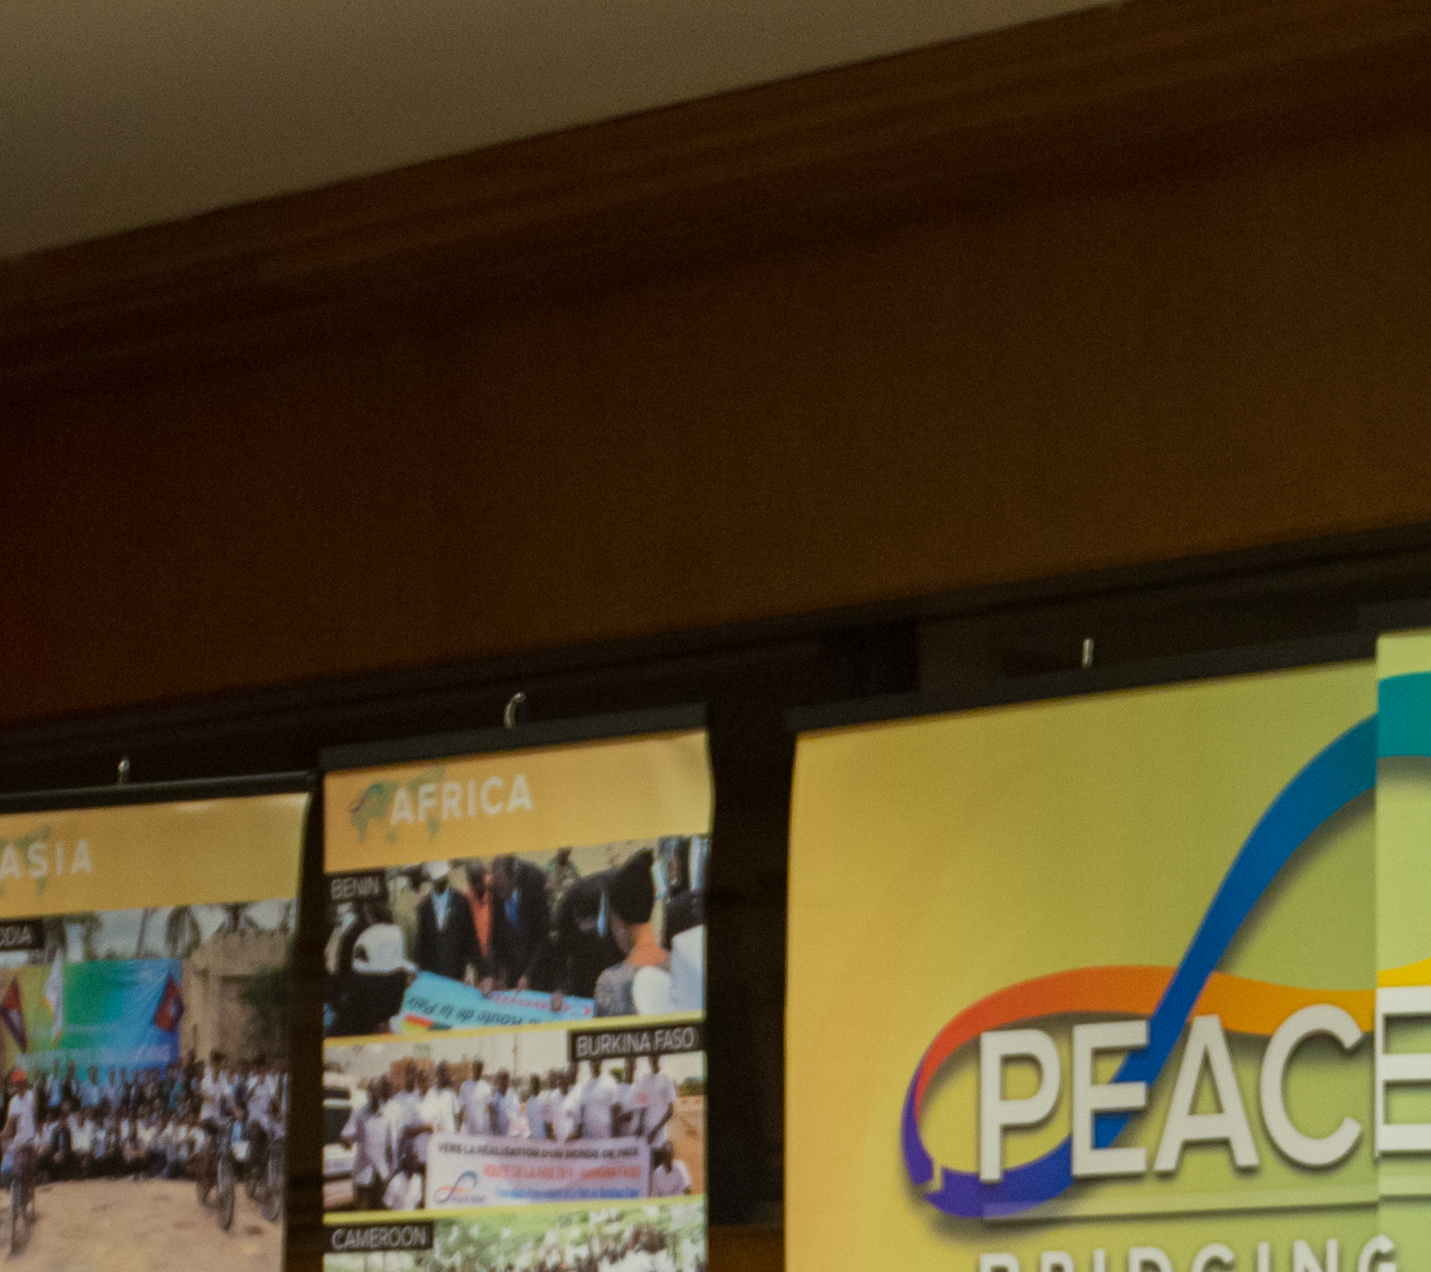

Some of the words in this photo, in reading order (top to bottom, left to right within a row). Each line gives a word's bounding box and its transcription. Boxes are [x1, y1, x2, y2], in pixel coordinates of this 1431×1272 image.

[390, 774, 533, 826] AFRICA
[330, 876, 380, 899] BENIN
[577, 1032, 652, 1058] BURKINA
[655, 1028, 695, 1050] FASO
[332, 1226, 426, 1250] CAMEROON
